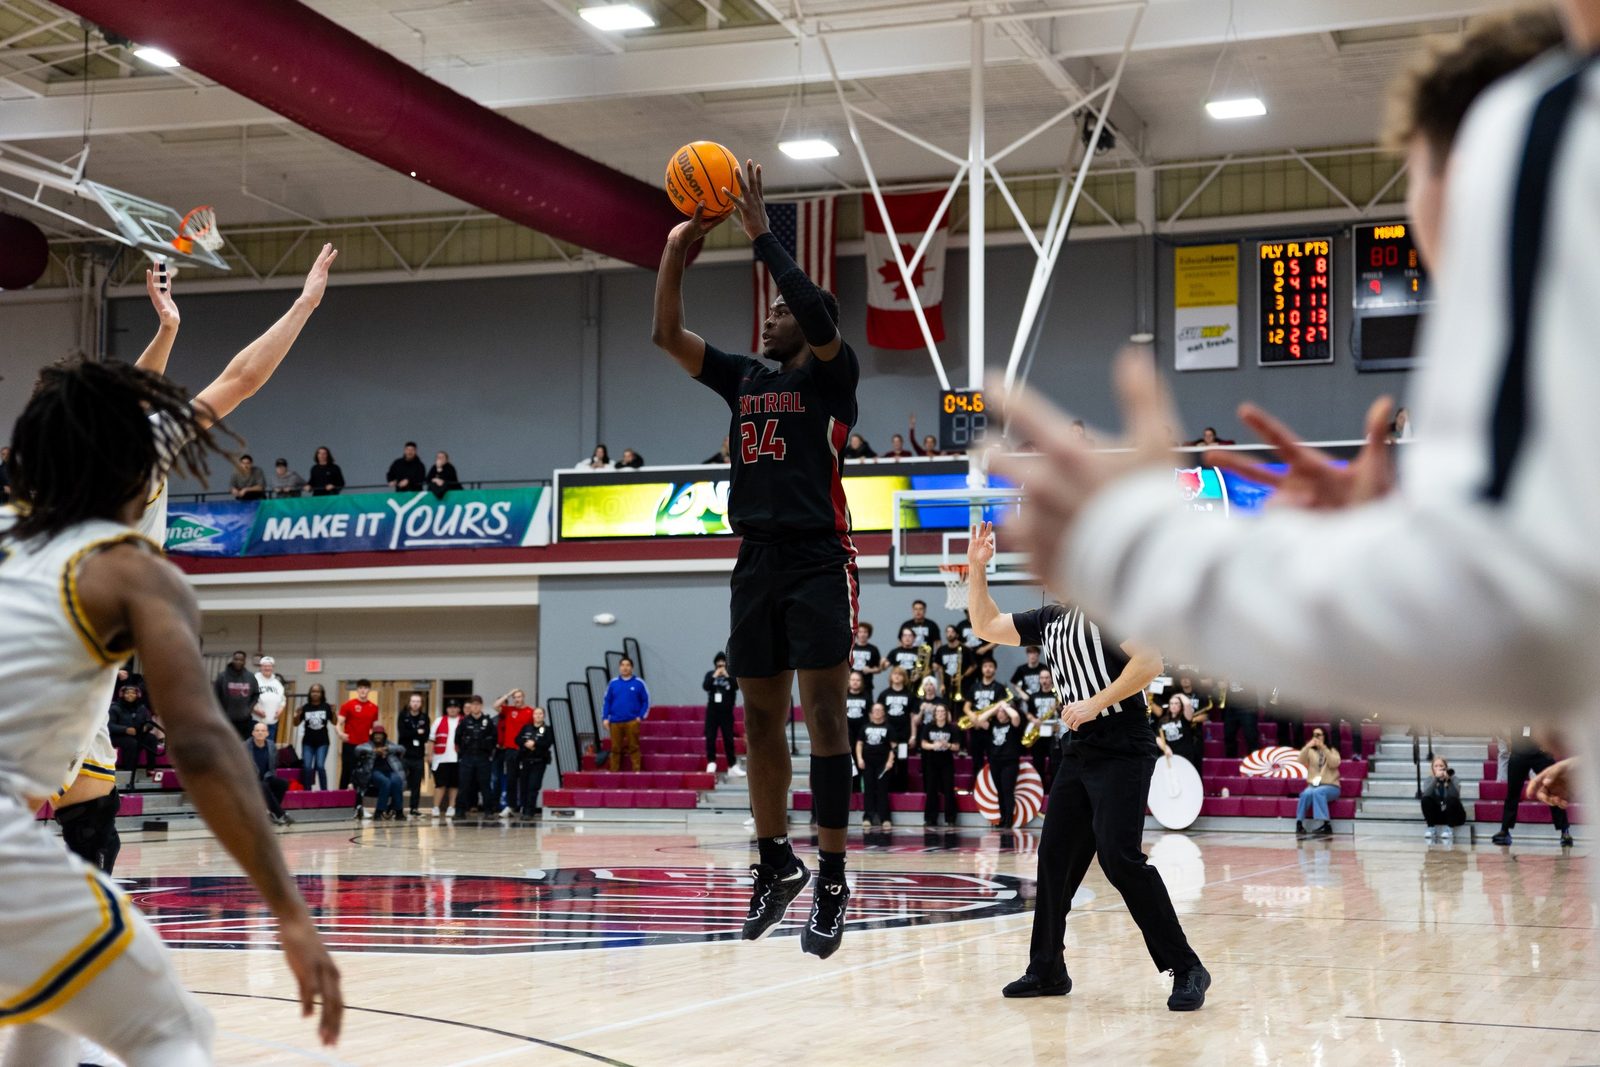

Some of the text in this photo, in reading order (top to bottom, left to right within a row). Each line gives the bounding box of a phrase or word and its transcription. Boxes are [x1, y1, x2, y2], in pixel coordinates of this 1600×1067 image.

[677, 150, 704, 197] Wilson
[1304, 241, 1328, 256] PTS
[1273, 257, 1327, 276] 0 5 8
[1273, 275, 1327, 292] 2 4 14
[1275, 293, 1327, 310] 3 1 11
[1268, 308, 1327, 326] 11 0 13
[1268, 325, 1327, 344] 12 2 27
[1289, 344, 1300, 359] 9
[943, 393, 985, 414] 04.6
[740, 418, 787, 464] 24
[262, 490, 512, 550] MAKE IT YOURS
